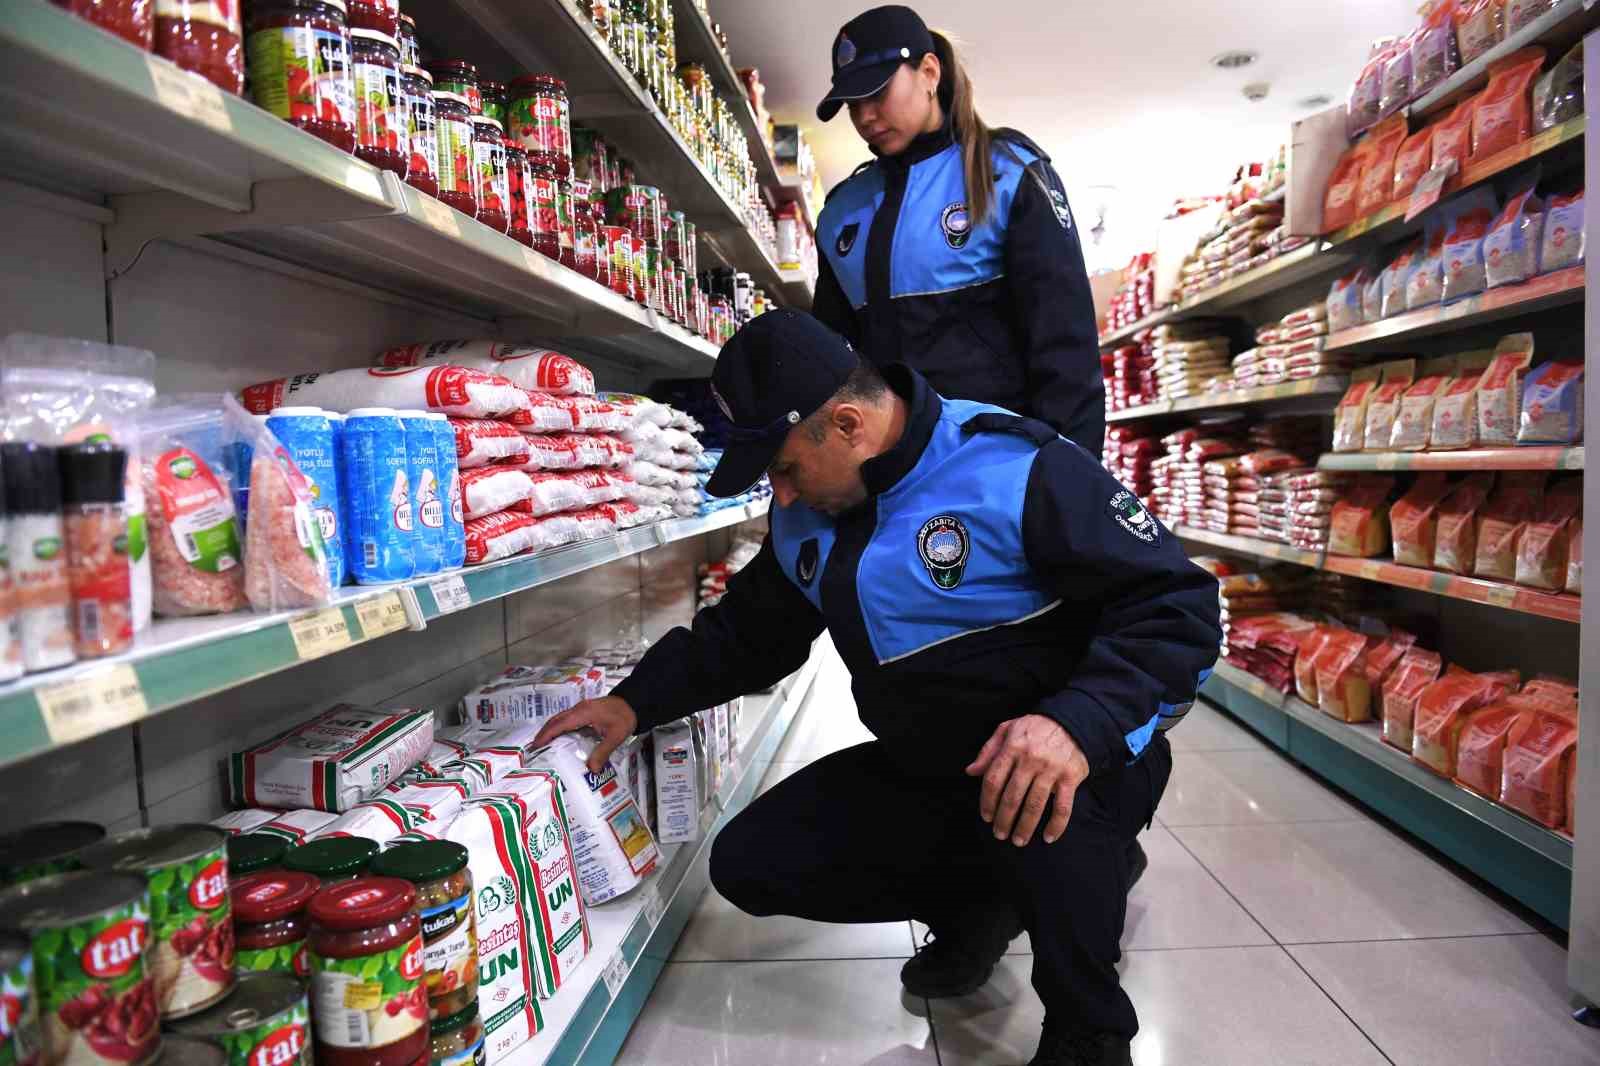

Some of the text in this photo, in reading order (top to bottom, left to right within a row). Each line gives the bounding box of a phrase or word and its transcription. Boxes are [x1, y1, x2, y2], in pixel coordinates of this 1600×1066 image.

[548, 877, 574, 911] UN
[91, 925, 141, 971] tat
[478, 920, 520, 957] esintaş
[479, 946, 519, 987] UN
[256, 1031, 300, 1066] tat
